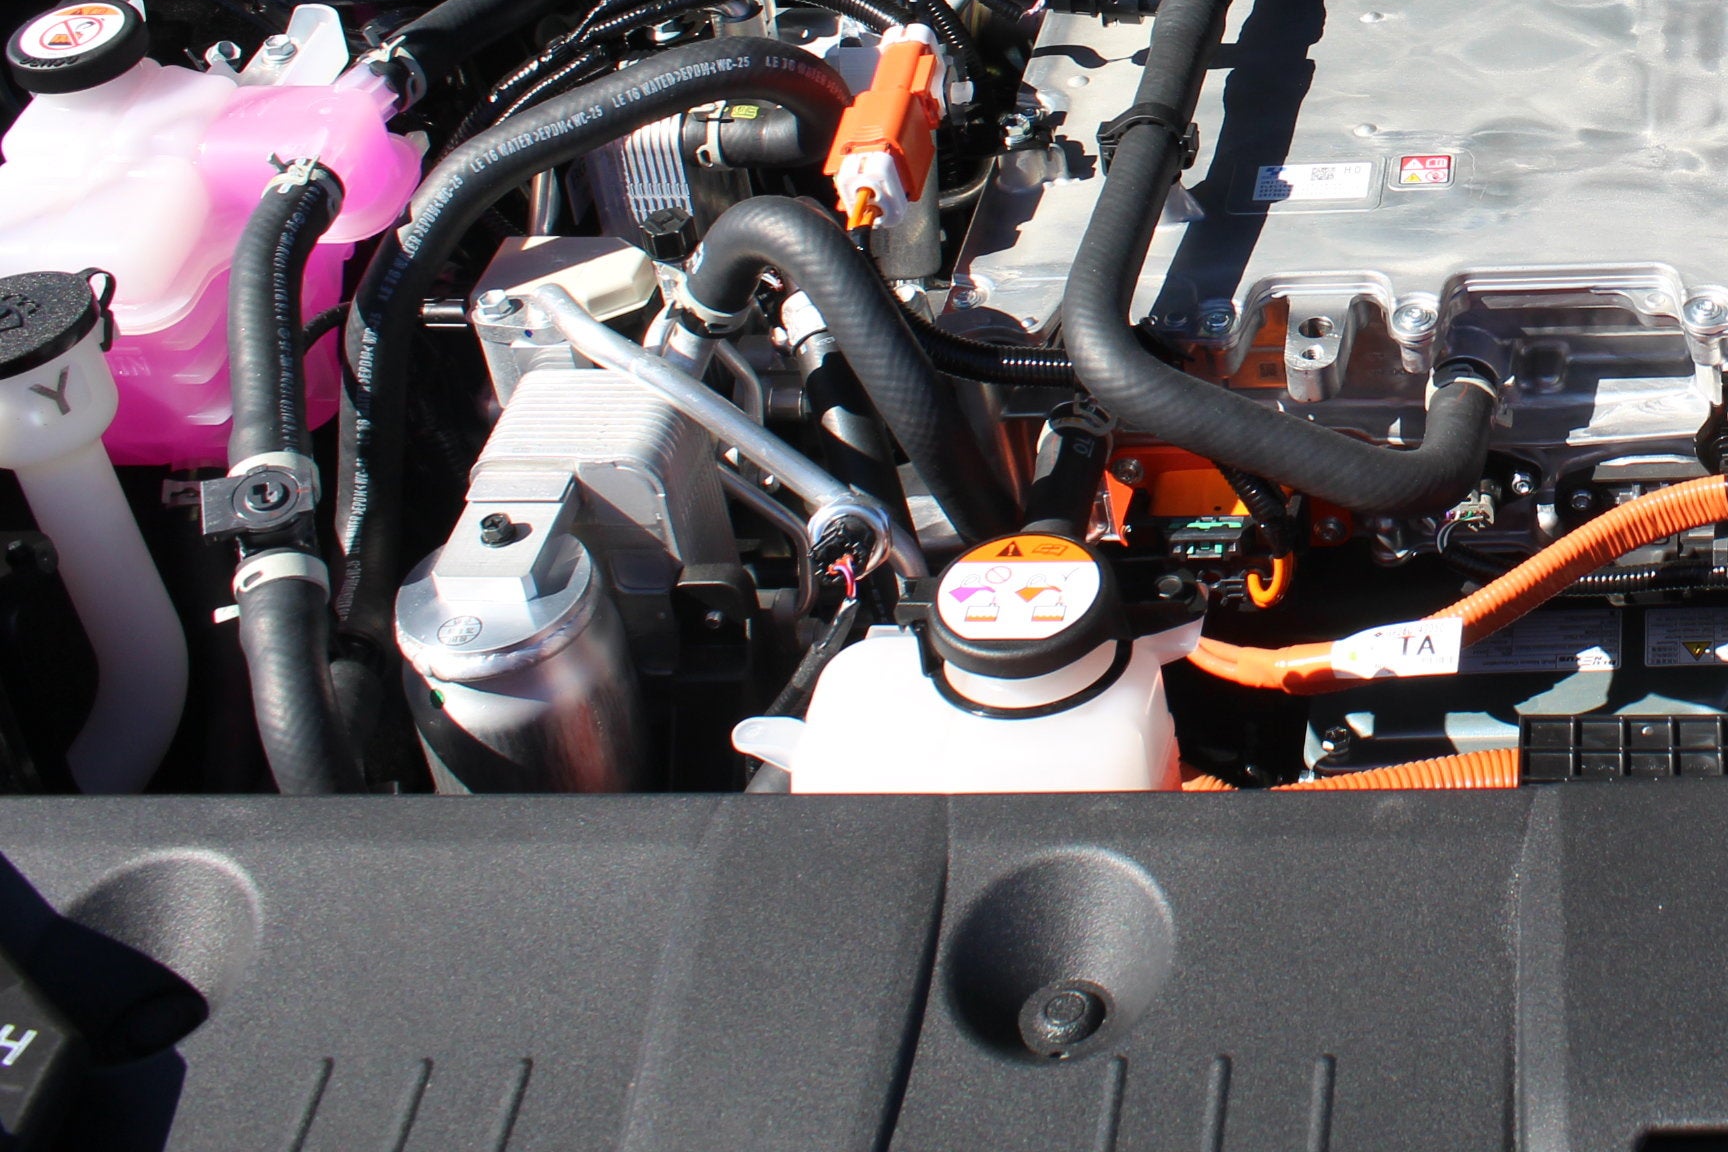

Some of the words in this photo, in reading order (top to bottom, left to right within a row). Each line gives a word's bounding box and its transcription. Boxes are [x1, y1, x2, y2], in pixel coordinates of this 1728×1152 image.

[28, 364, 71, 416] Y
[1397, 634, 1436, 656] TA
[0, 1022, 39, 1066] H
